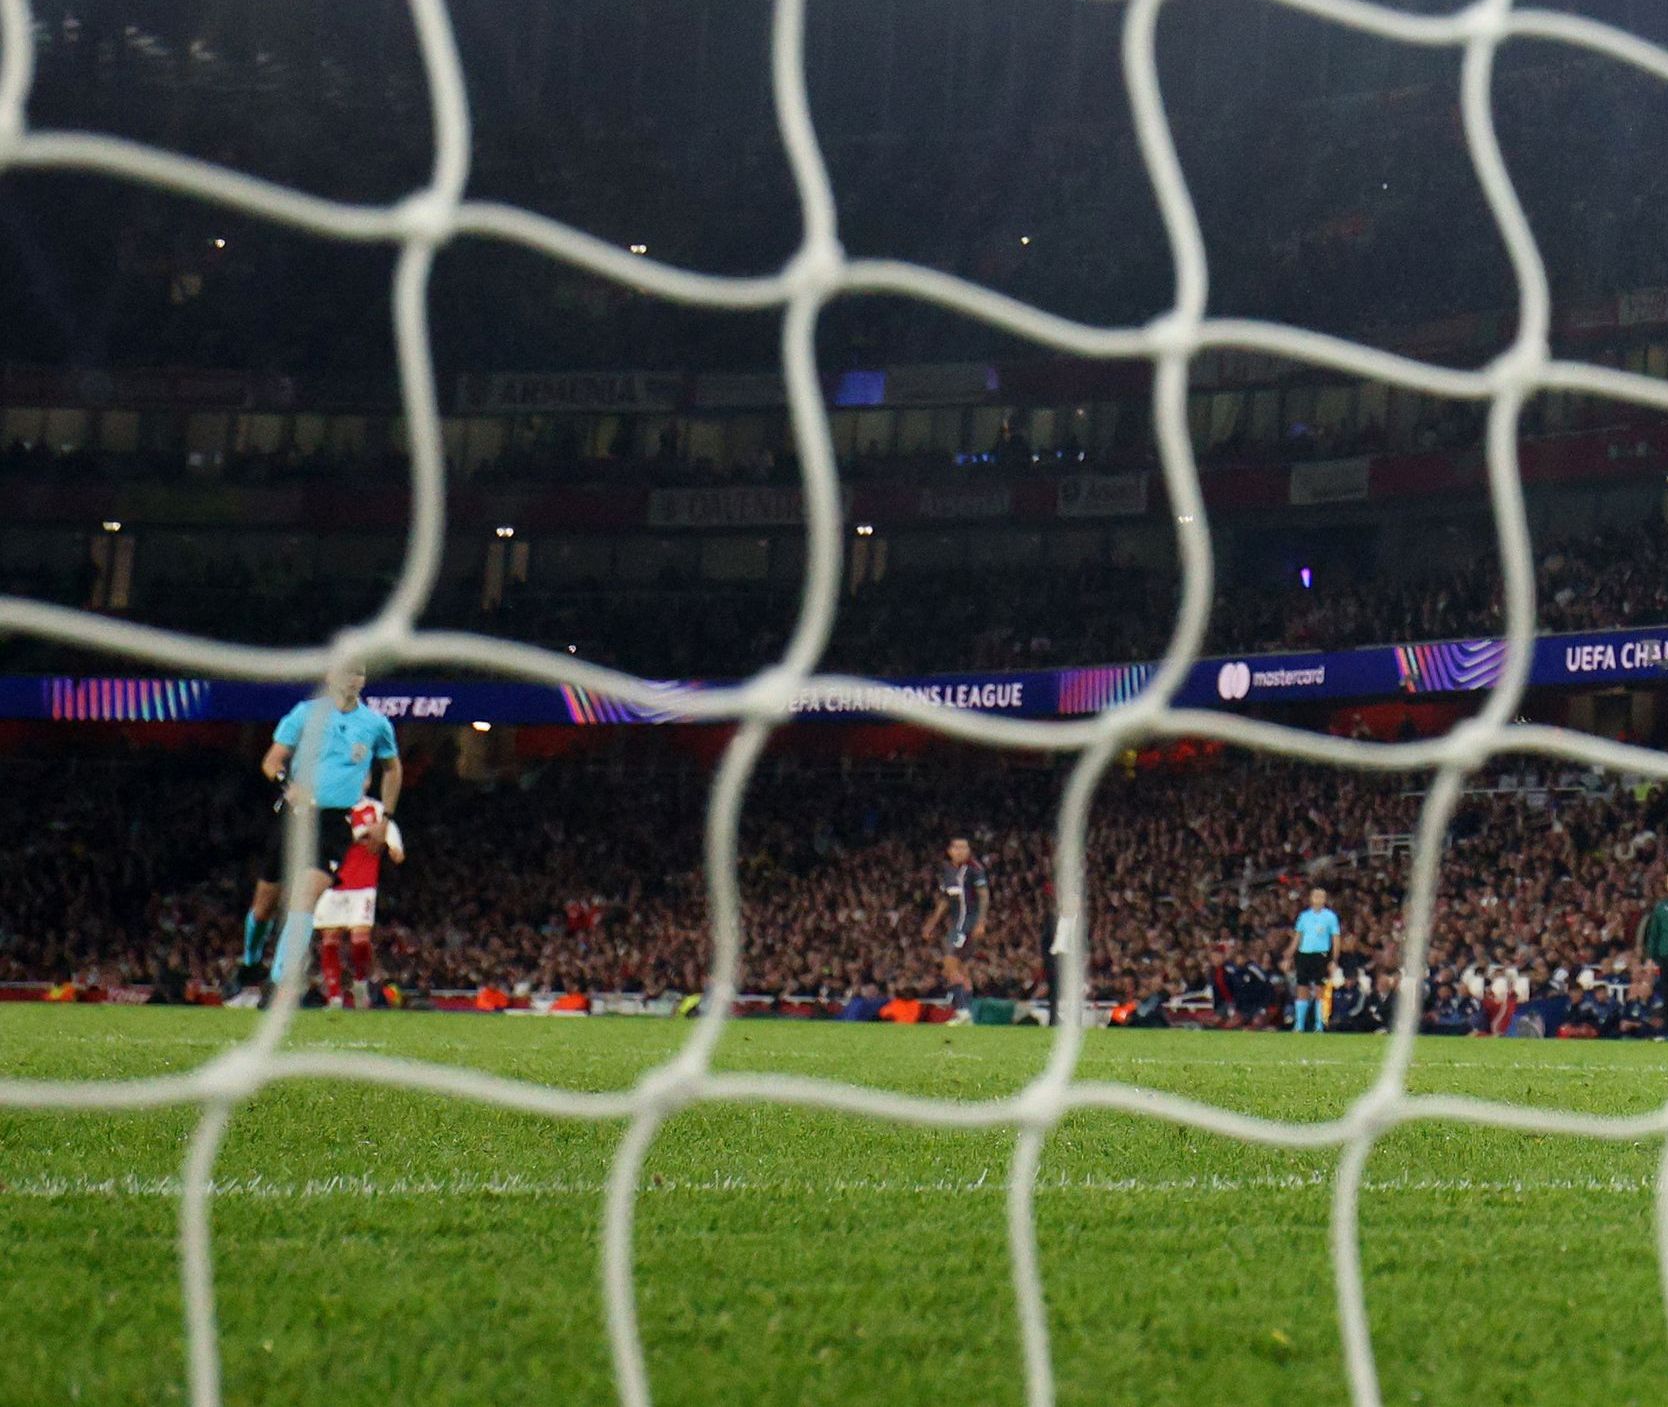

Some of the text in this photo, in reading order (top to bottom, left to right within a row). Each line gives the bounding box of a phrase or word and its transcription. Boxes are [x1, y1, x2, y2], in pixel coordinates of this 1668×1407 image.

[1566, 645, 1616, 672] UEFA
[1252, 664, 1325, 687] mastercard
[412, 696, 453, 718] EAT
[945, 682, 1023, 709] LEAGUE
